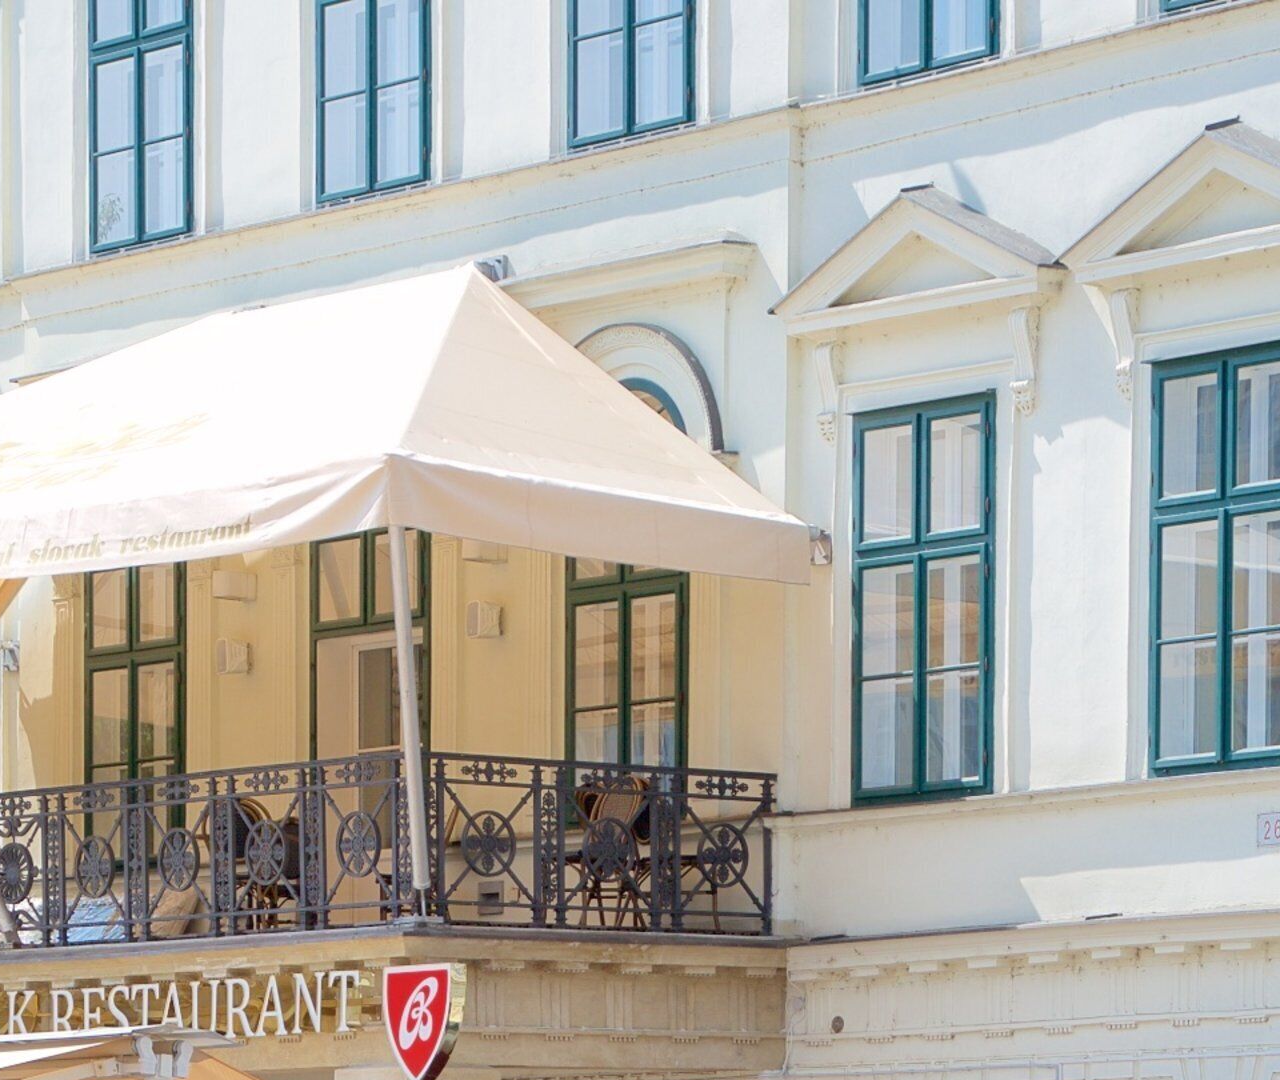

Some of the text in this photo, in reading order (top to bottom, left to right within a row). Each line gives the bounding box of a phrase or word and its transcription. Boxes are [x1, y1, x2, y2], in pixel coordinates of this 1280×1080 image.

[26, 533, 106, 565] slovak
[120, 512, 254, 556] restaurant
[51, 970, 360, 1038] RESTAURANT
